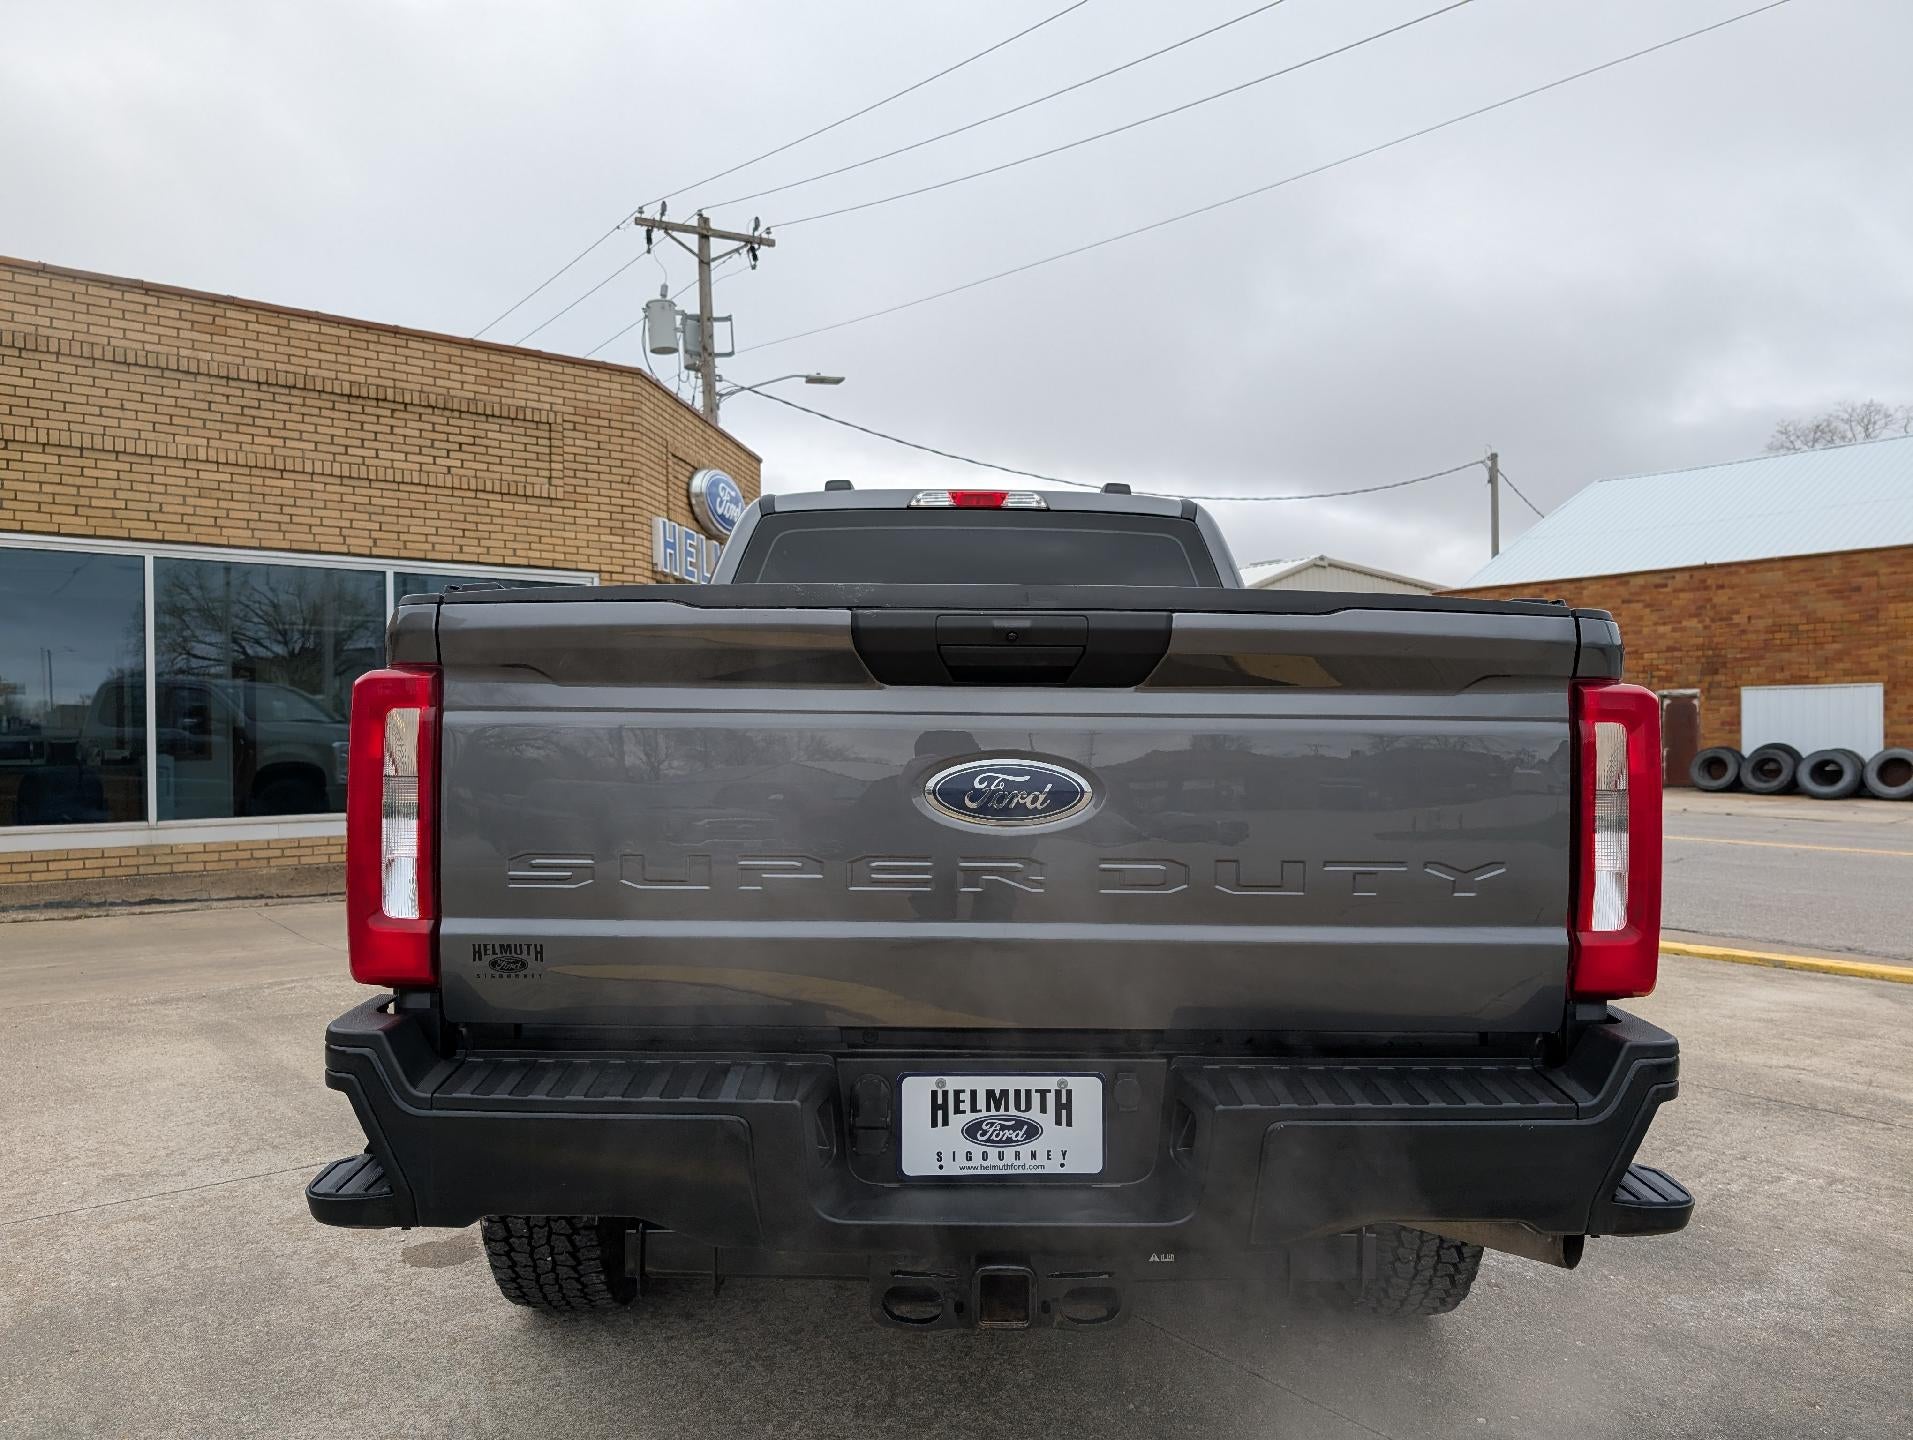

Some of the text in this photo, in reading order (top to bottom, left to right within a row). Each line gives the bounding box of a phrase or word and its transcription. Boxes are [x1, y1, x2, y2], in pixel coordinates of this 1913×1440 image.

[716, 483, 742, 522] Ford
[964, 772, 1053, 810] Ford
[507, 852, 1507, 897] SUPER DUTY
[472, 943, 544, 962] HELMUTH
[931, 1088, 1073, 1128] HELMUTH
[977, 1119, 1026, 1141] Ford
[936, 1150, 1068, 1163] SIGOURNEY
[958, 1163, 1046, 1171] www.helmuthford.com
